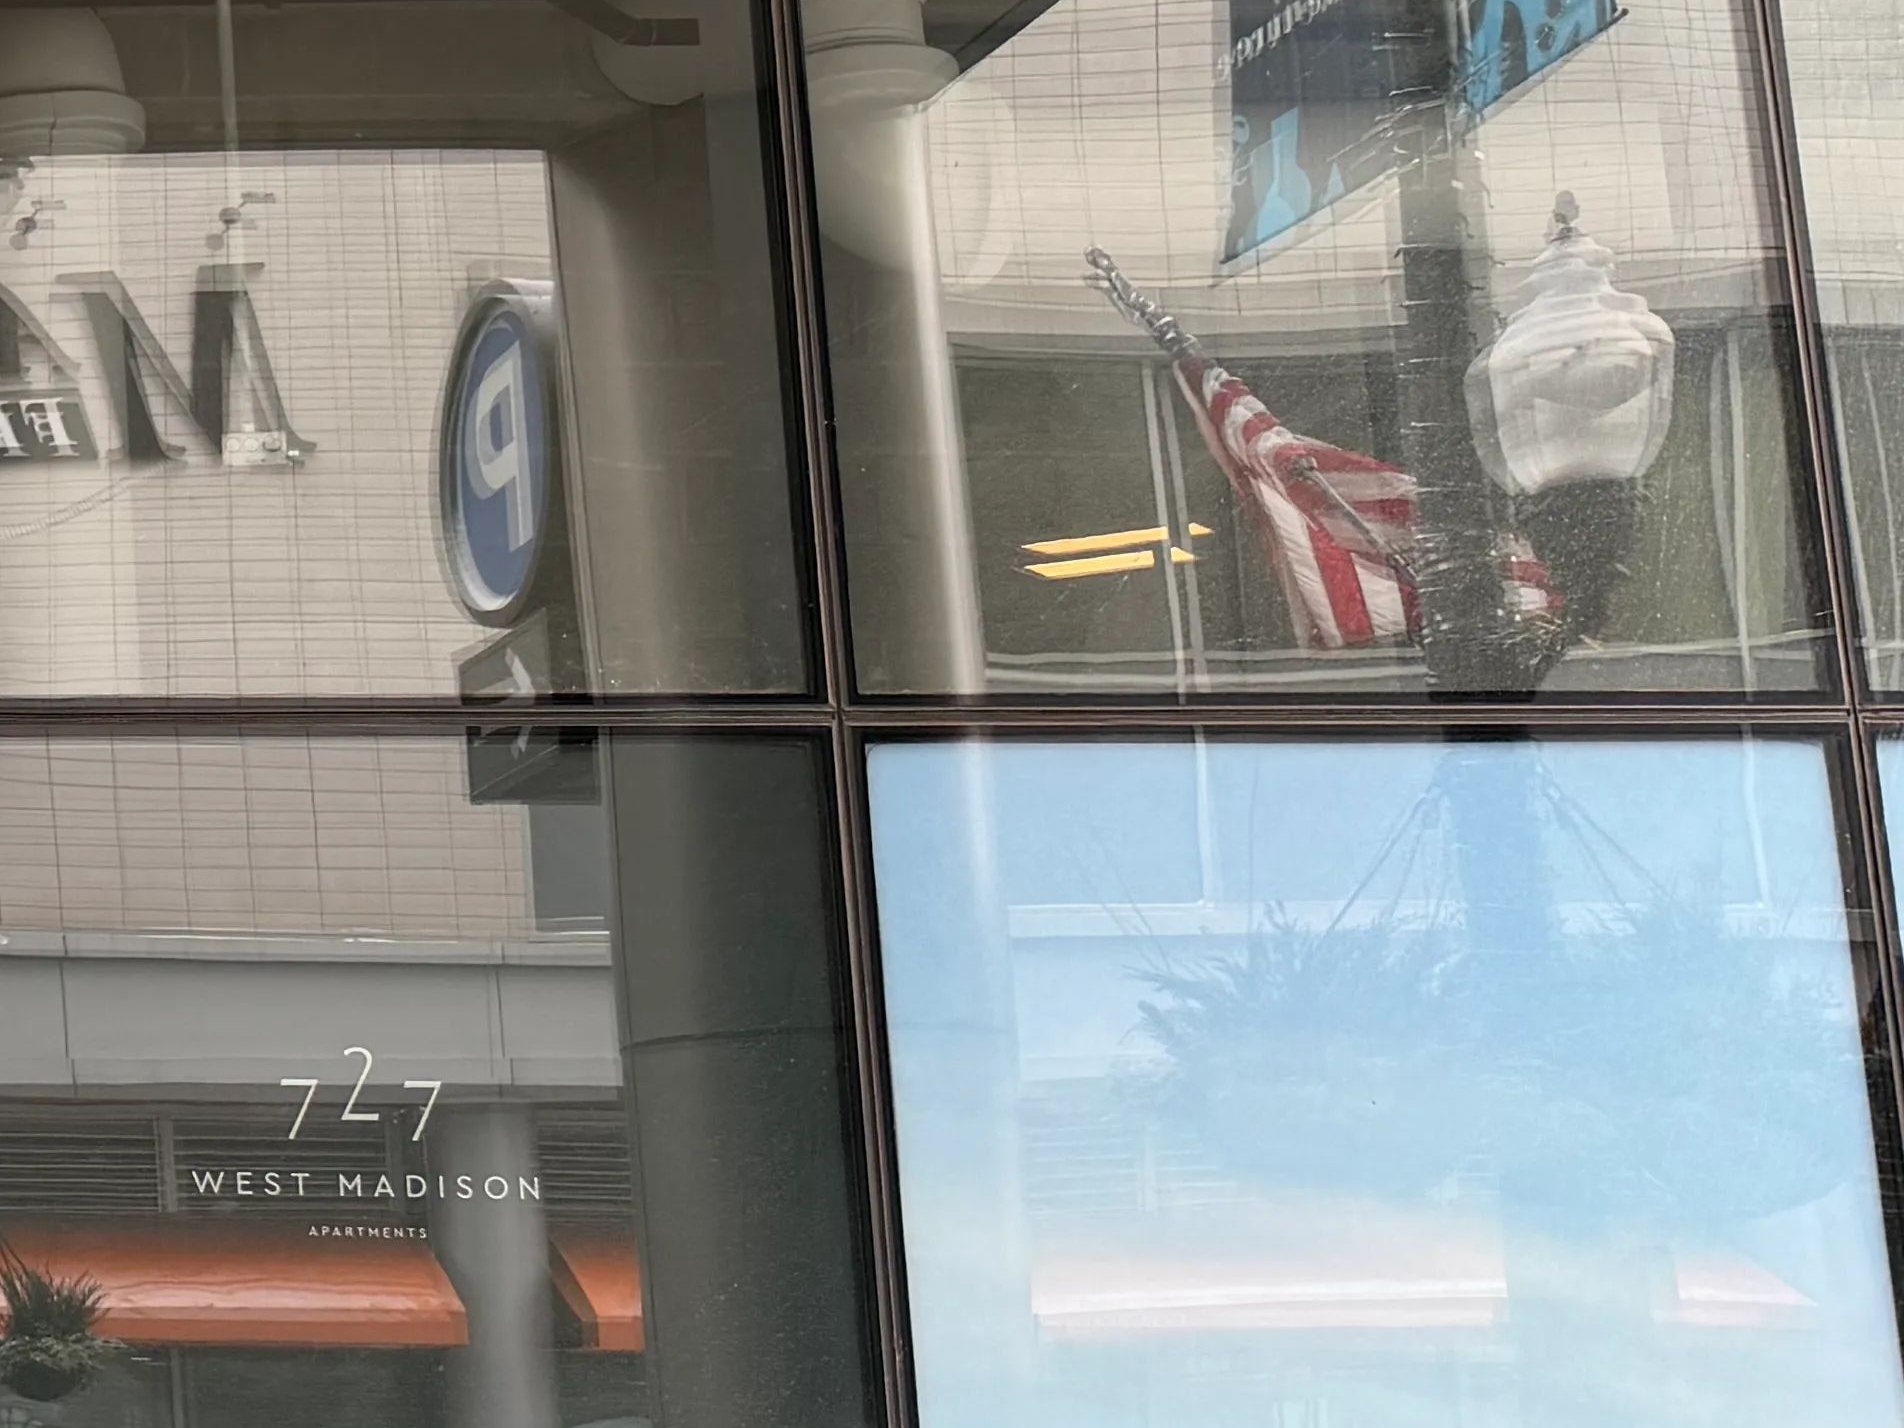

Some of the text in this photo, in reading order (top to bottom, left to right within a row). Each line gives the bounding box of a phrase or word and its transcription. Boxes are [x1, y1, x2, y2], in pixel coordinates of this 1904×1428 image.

[279, 1046, 443, 1142] 727
[192, 1171, 542, 1201] WEST MADISON
[308, 1225, 428, 1239] APARTMENTS
